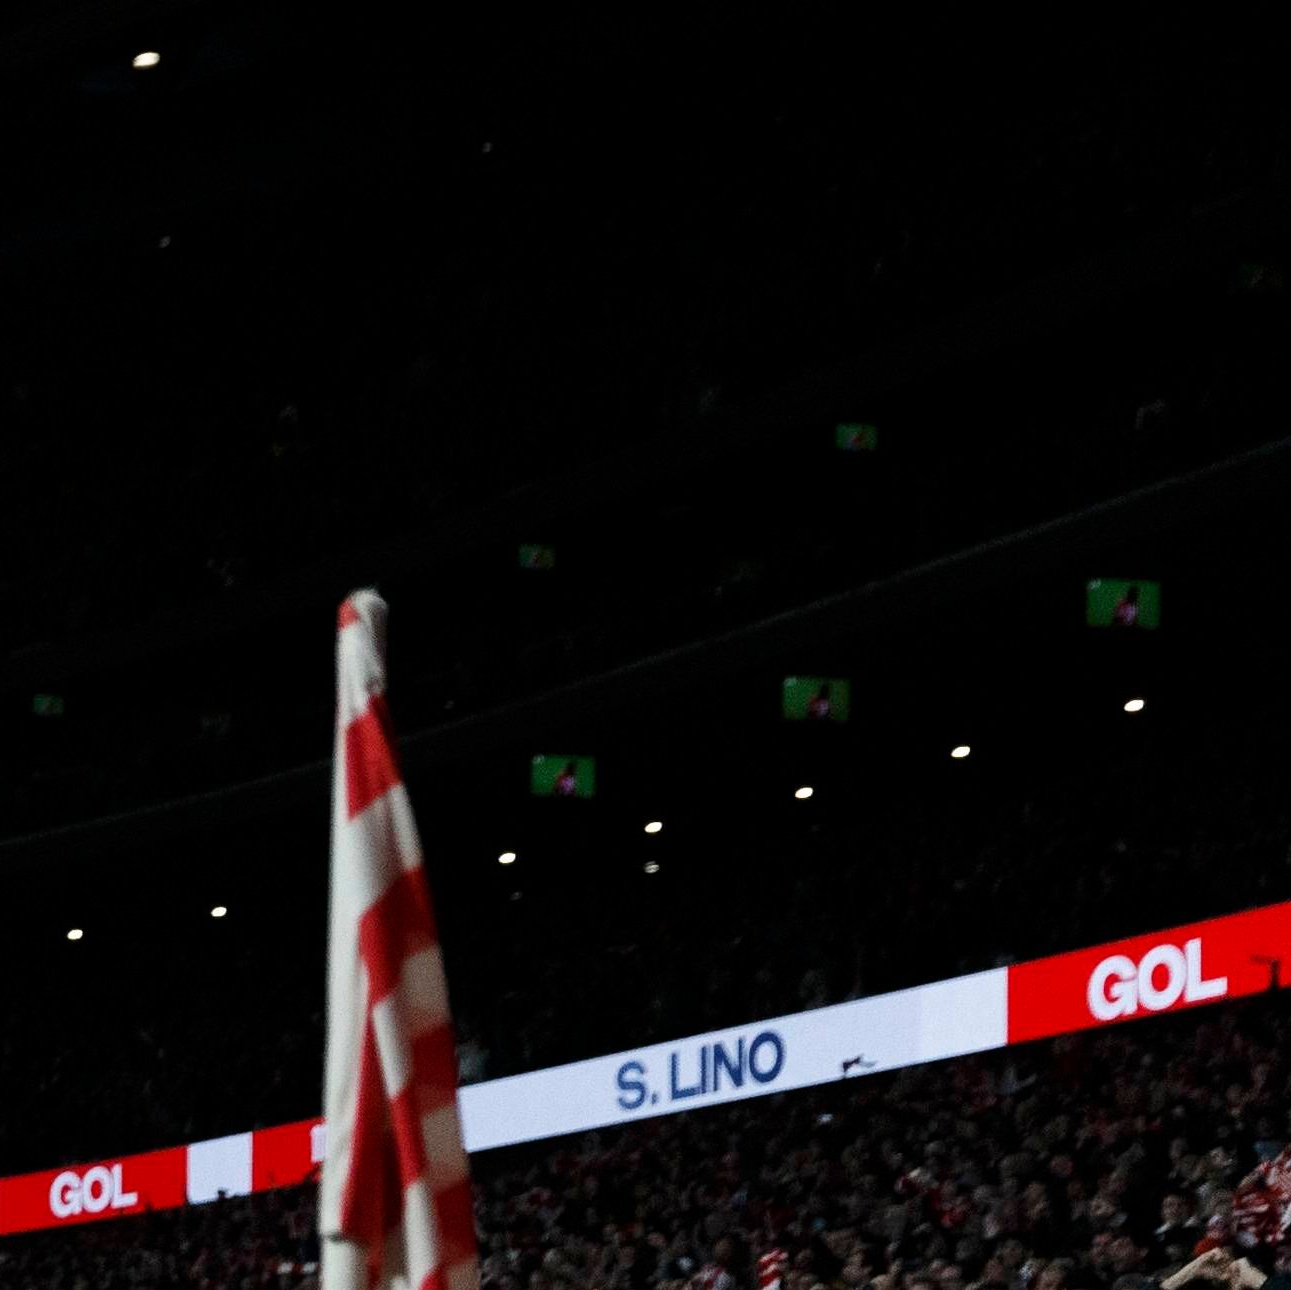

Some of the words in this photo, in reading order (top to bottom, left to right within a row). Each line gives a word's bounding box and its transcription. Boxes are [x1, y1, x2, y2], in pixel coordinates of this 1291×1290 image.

[1088, 938, 1228, 1022] GOL
[617, 1060, 660, 1110] S.
[670, 1032, 785, 1101] LINO
[50, 1162, 137, 1219] GOL
